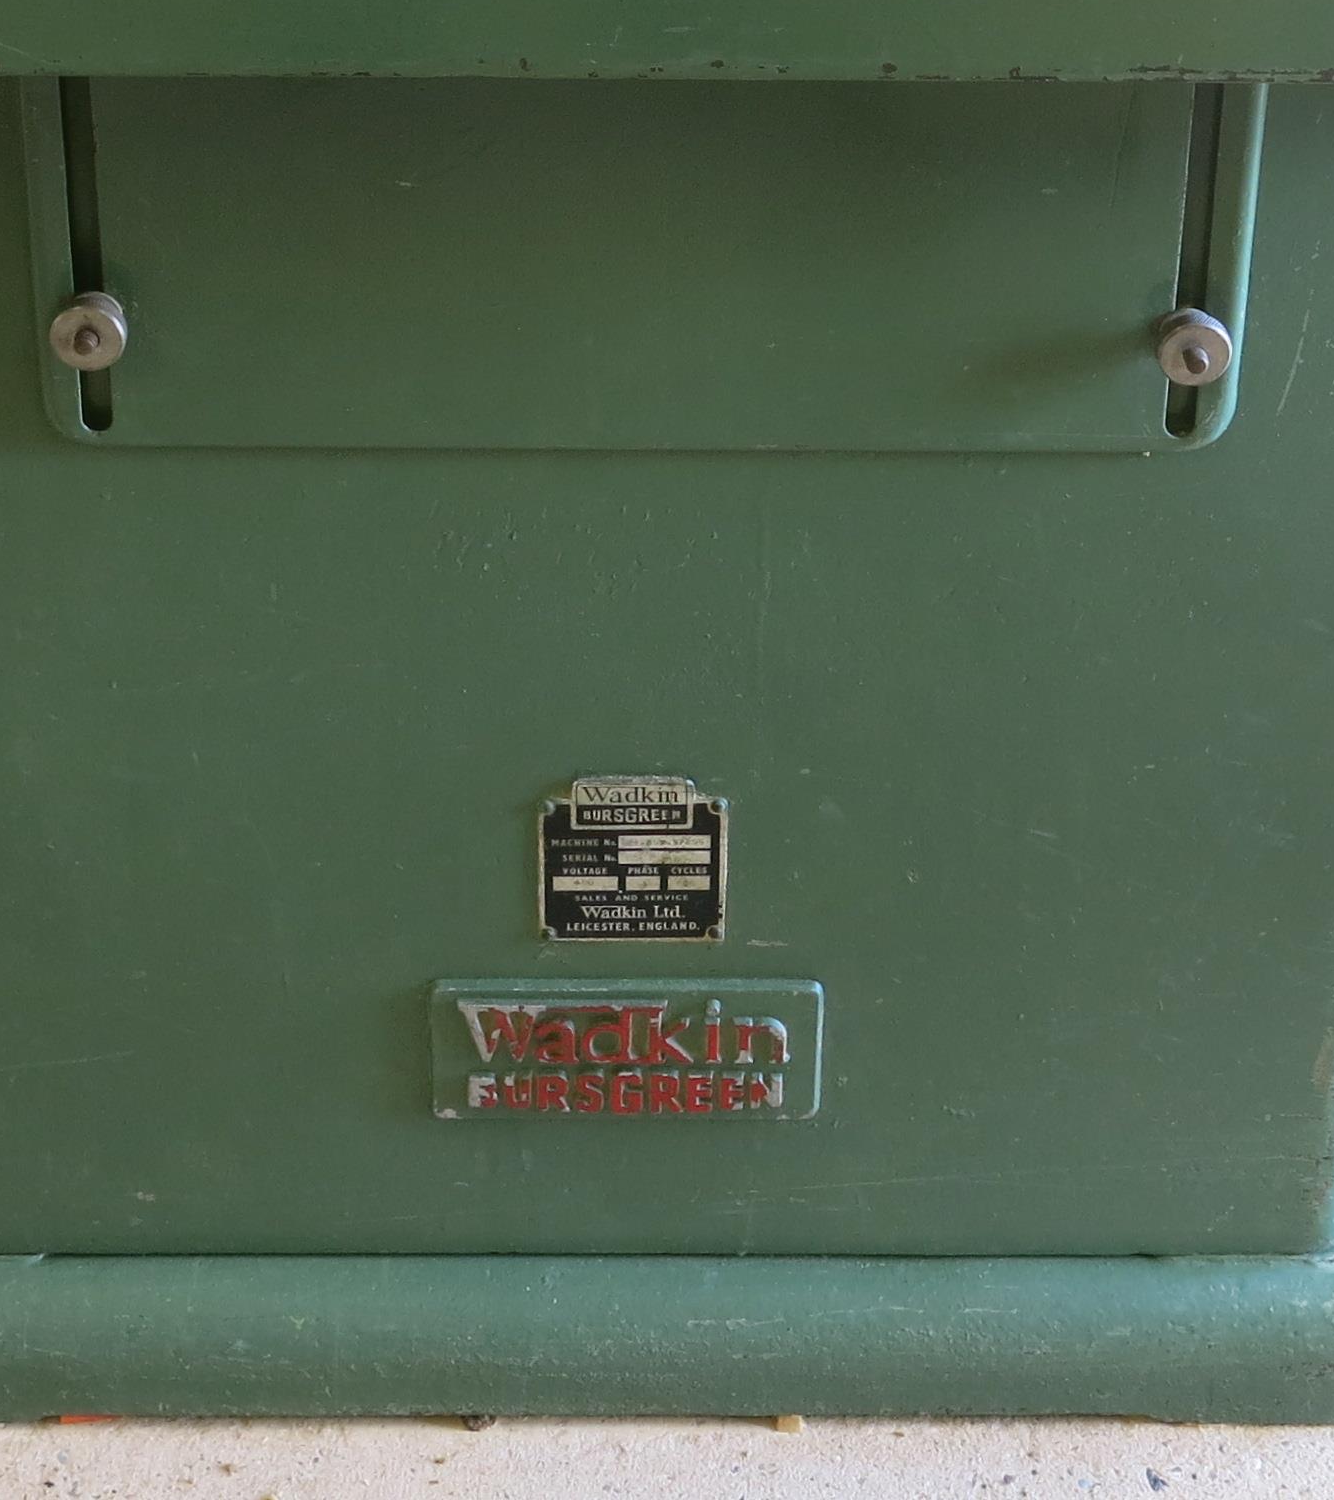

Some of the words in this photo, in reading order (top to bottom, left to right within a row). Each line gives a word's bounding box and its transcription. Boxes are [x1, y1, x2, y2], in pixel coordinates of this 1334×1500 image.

[583, 785, 679, 804] Wadkin
[582, 807, 682, 823] BURSGREEN
[551, 838, 600, 847] MACHINE
[562, 853, 599, 862] SERIAL
[562, 867, 608, 875] VOLTAGE
[627, 866, 659, 875] PHASE
[670, 867, 708, 875] CYCLES
[644, 893, 688, 901] SERVICE
[580, 905, 647, 919] Wadkin
[654, 905, 686, 919] Ltd.
[639, 921, 701, 931] ENGLAND.
[458, 999, 791, 1065] Wadkin
[468, 1069, 784, 1115] BURSGREEN
